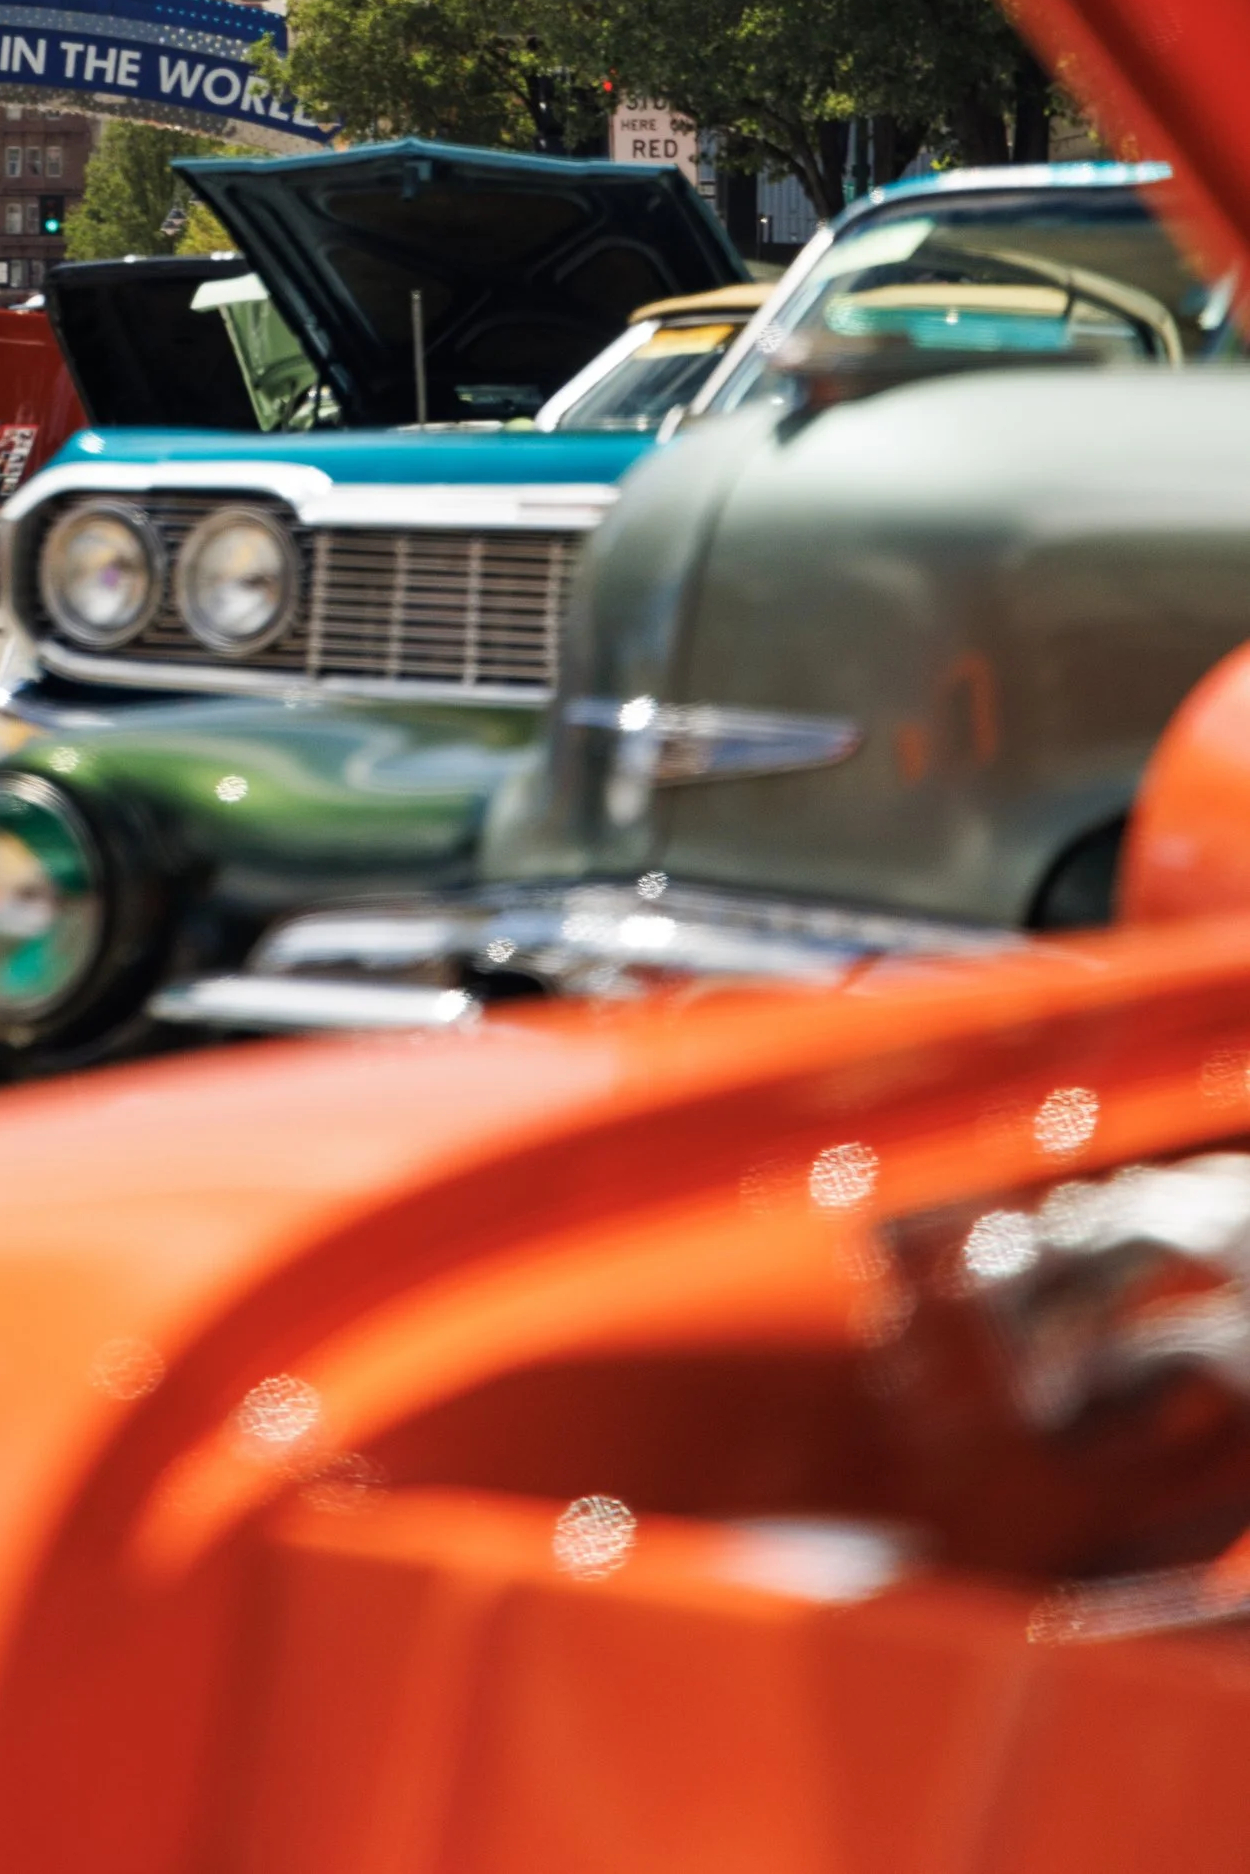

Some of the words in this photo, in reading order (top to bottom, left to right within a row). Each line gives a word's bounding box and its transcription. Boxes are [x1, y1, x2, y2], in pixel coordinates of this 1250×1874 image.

[0, 34, 47, 75] IN
[60, 41, 142, 88] THE
[620, 119, 657, 131] HERE
[632, 139, 678, 159] RED
